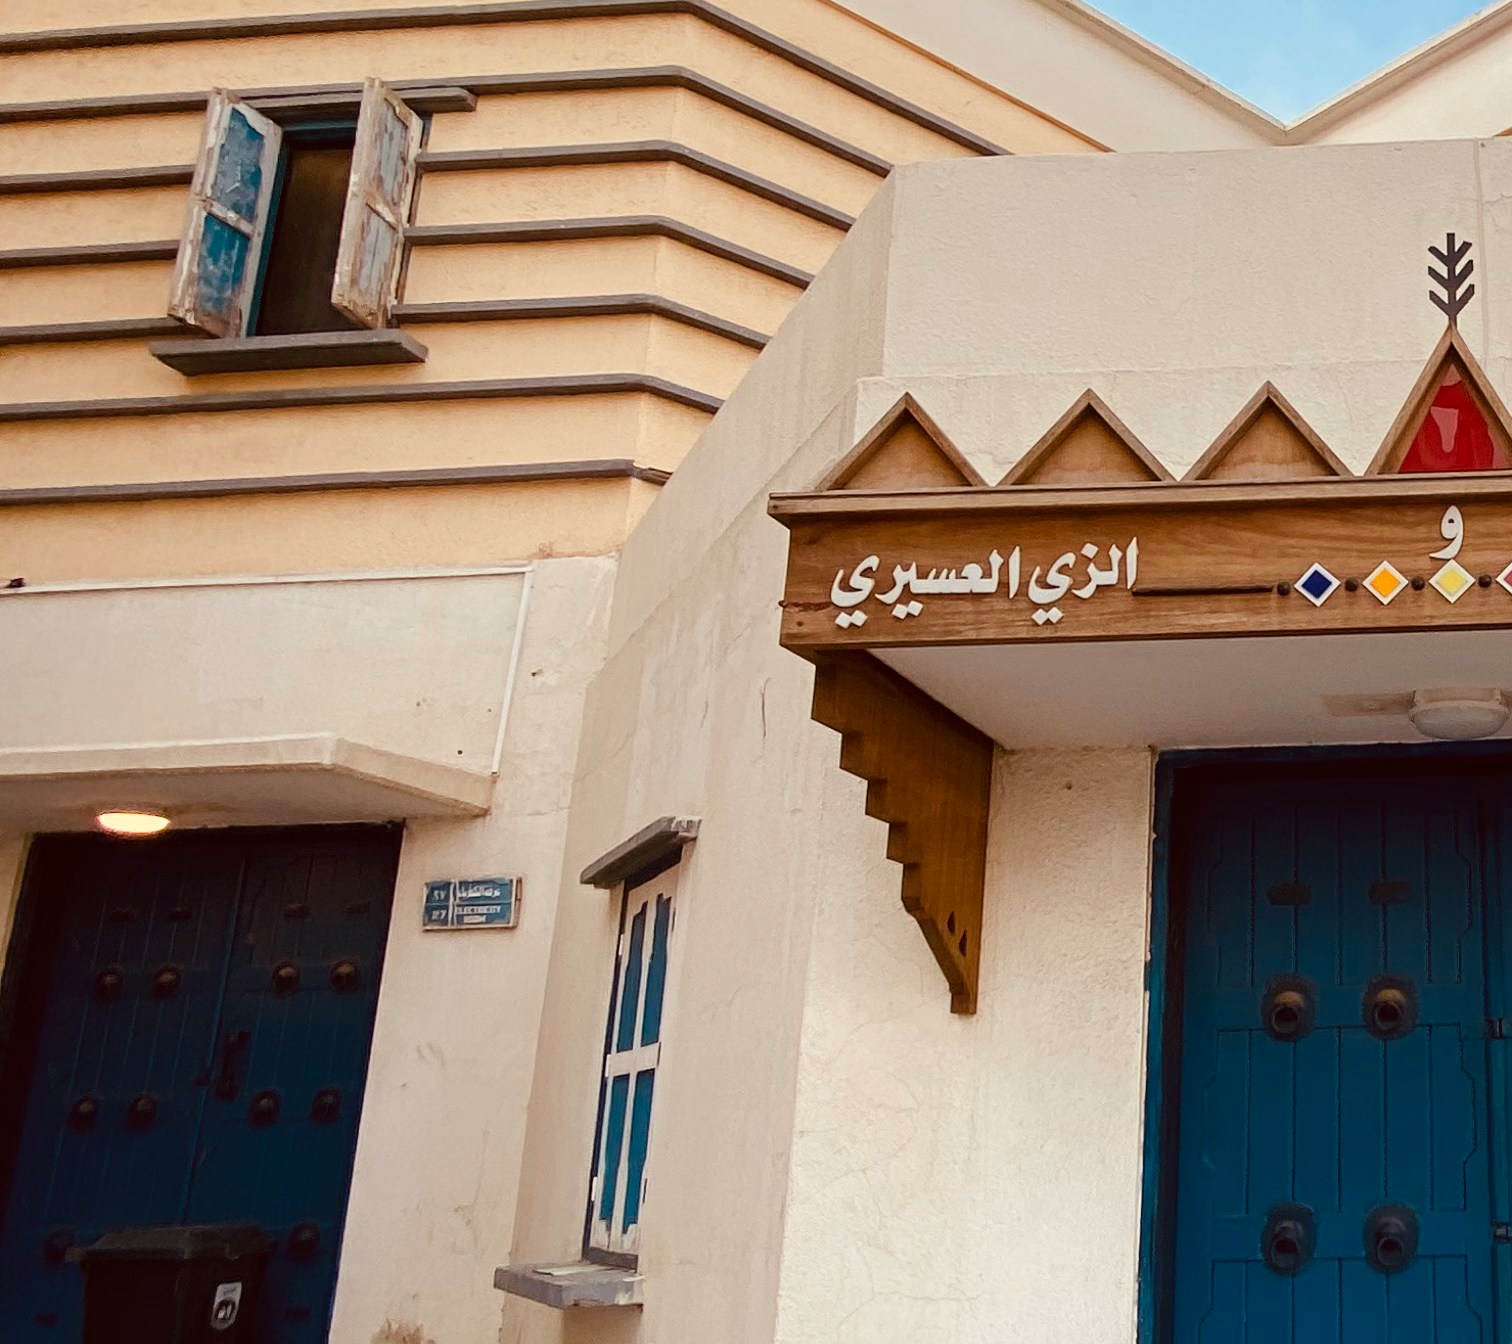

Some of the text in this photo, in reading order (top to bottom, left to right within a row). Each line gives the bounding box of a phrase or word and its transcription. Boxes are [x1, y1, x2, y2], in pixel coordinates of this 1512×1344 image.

[1428, 504, 1464, 560] و
[829, 545, 1022, 629] العسيري
[1027, 536, 1140, 626] الزي
